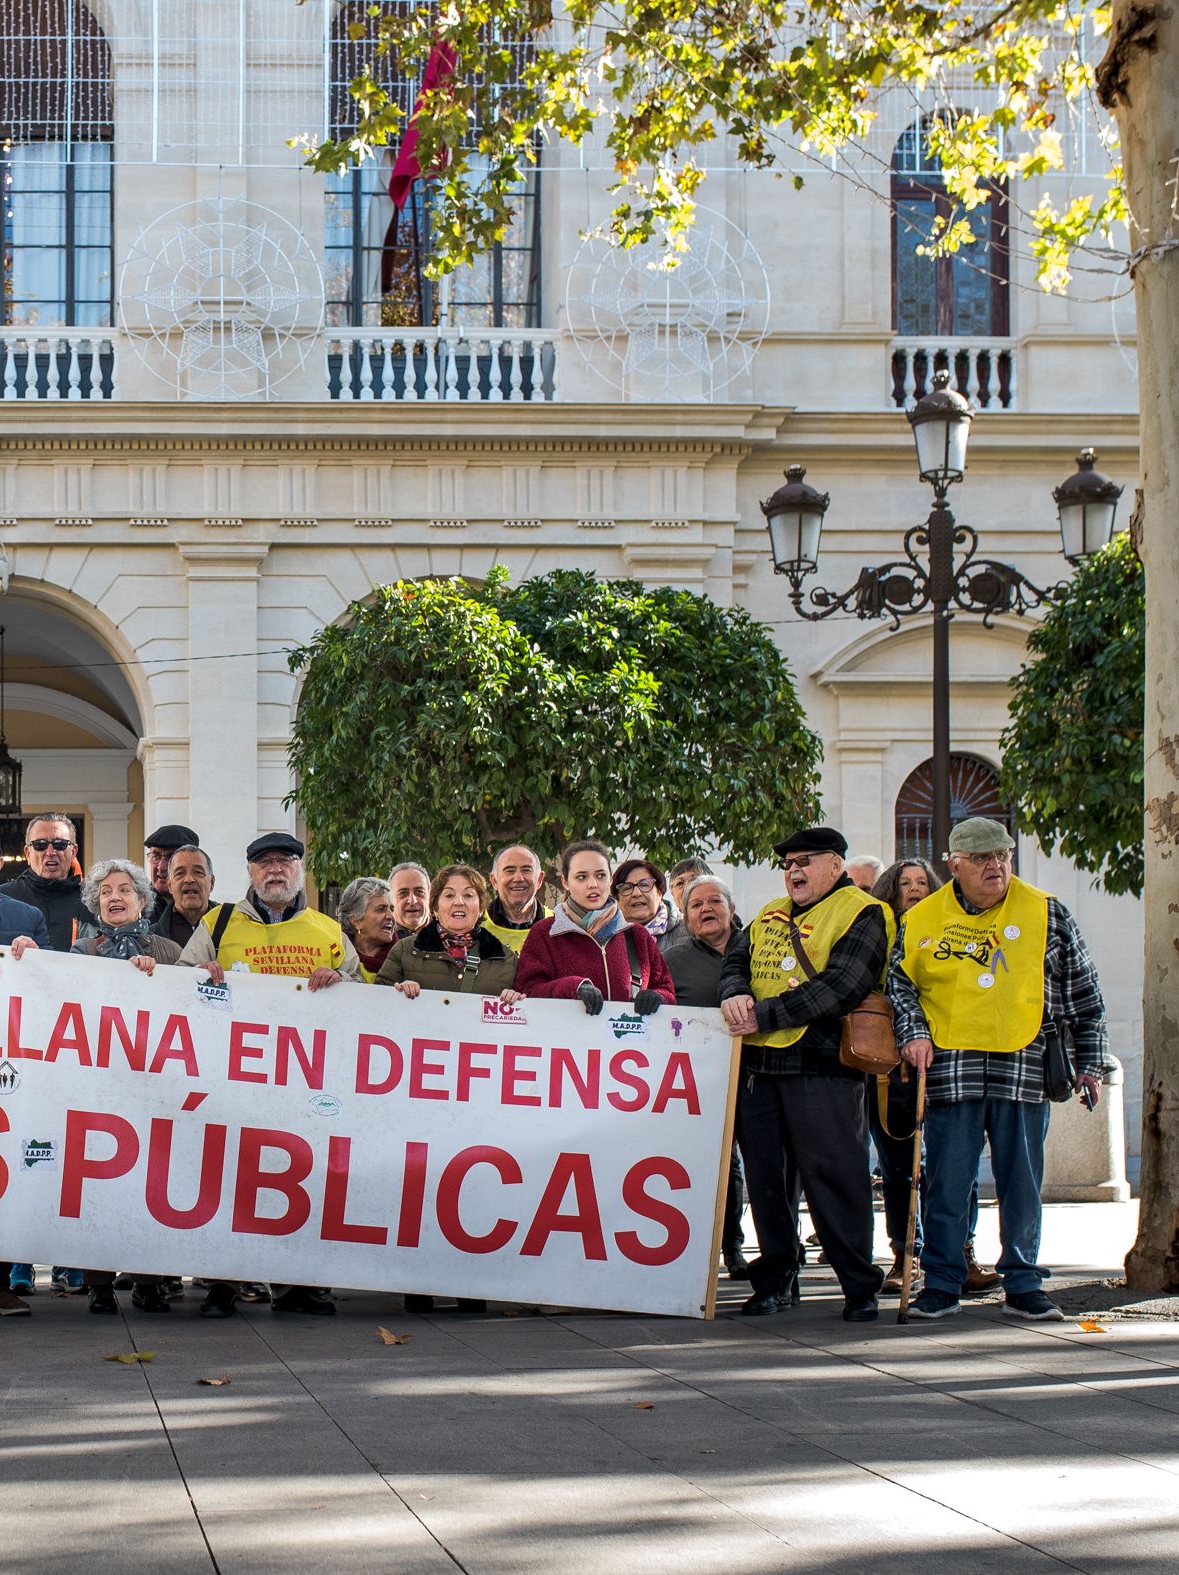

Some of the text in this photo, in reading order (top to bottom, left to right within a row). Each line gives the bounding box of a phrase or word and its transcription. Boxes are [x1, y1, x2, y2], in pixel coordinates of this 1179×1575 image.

[245, 945, 322, 957] PLATAFORMA
[253, 955, 315, 966] SEVILLANA
[260, 966, 313, 975] DEFENSA
[612, 1022, 642, 1031] M.A.D.P.P.
[227, 1021, 327, 1090] EN
[355, 1033, 701, 1114] DEFENSA
[59, 1090, 690, 1264] PÚBLICAS
